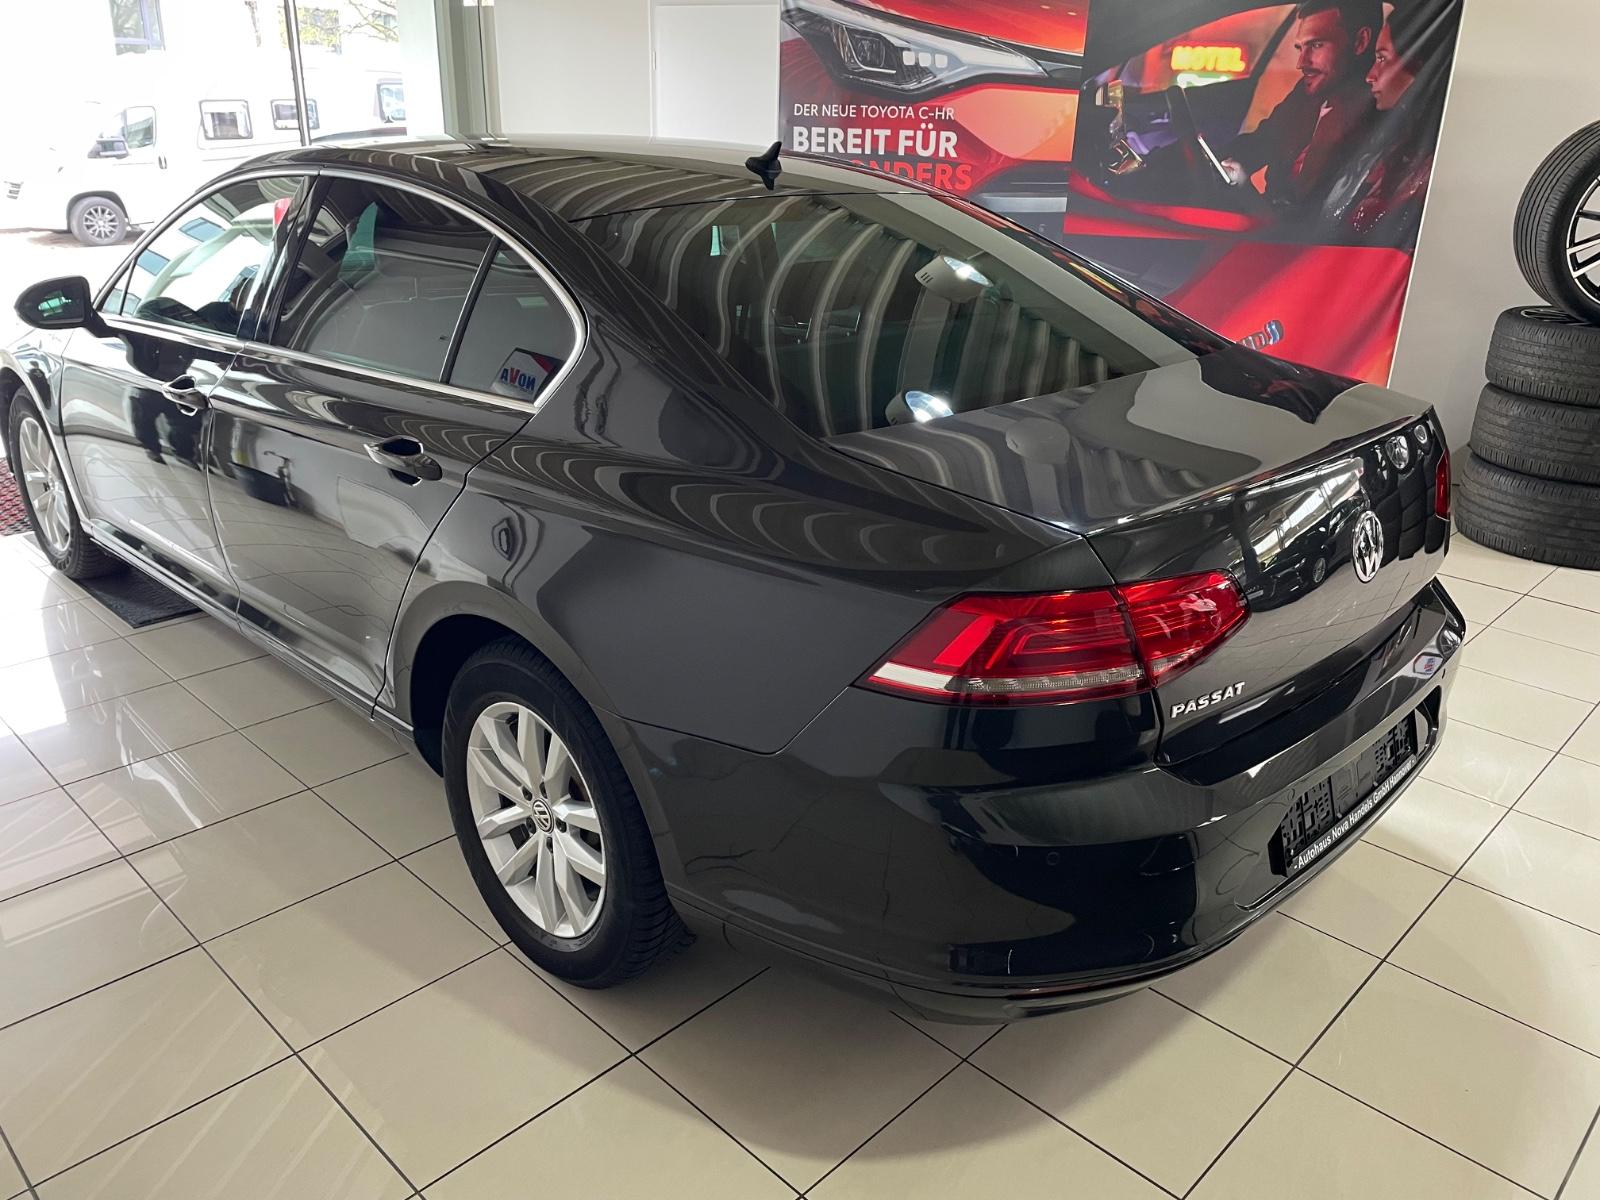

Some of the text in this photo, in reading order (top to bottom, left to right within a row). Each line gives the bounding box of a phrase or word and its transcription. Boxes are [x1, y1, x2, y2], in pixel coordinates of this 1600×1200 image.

[793, 103, 955, 120] DER NEUE TOYOTA C-HR
[792, 122, 958, 158] BEREIT FÜR
[1170, 681, 1246, 718] PASSAT
[1297, 835, 1332, 868] Autohaus
[1331, 821, 1350, 841] Nova
[1373, 781, 1390, 803] GmbH
